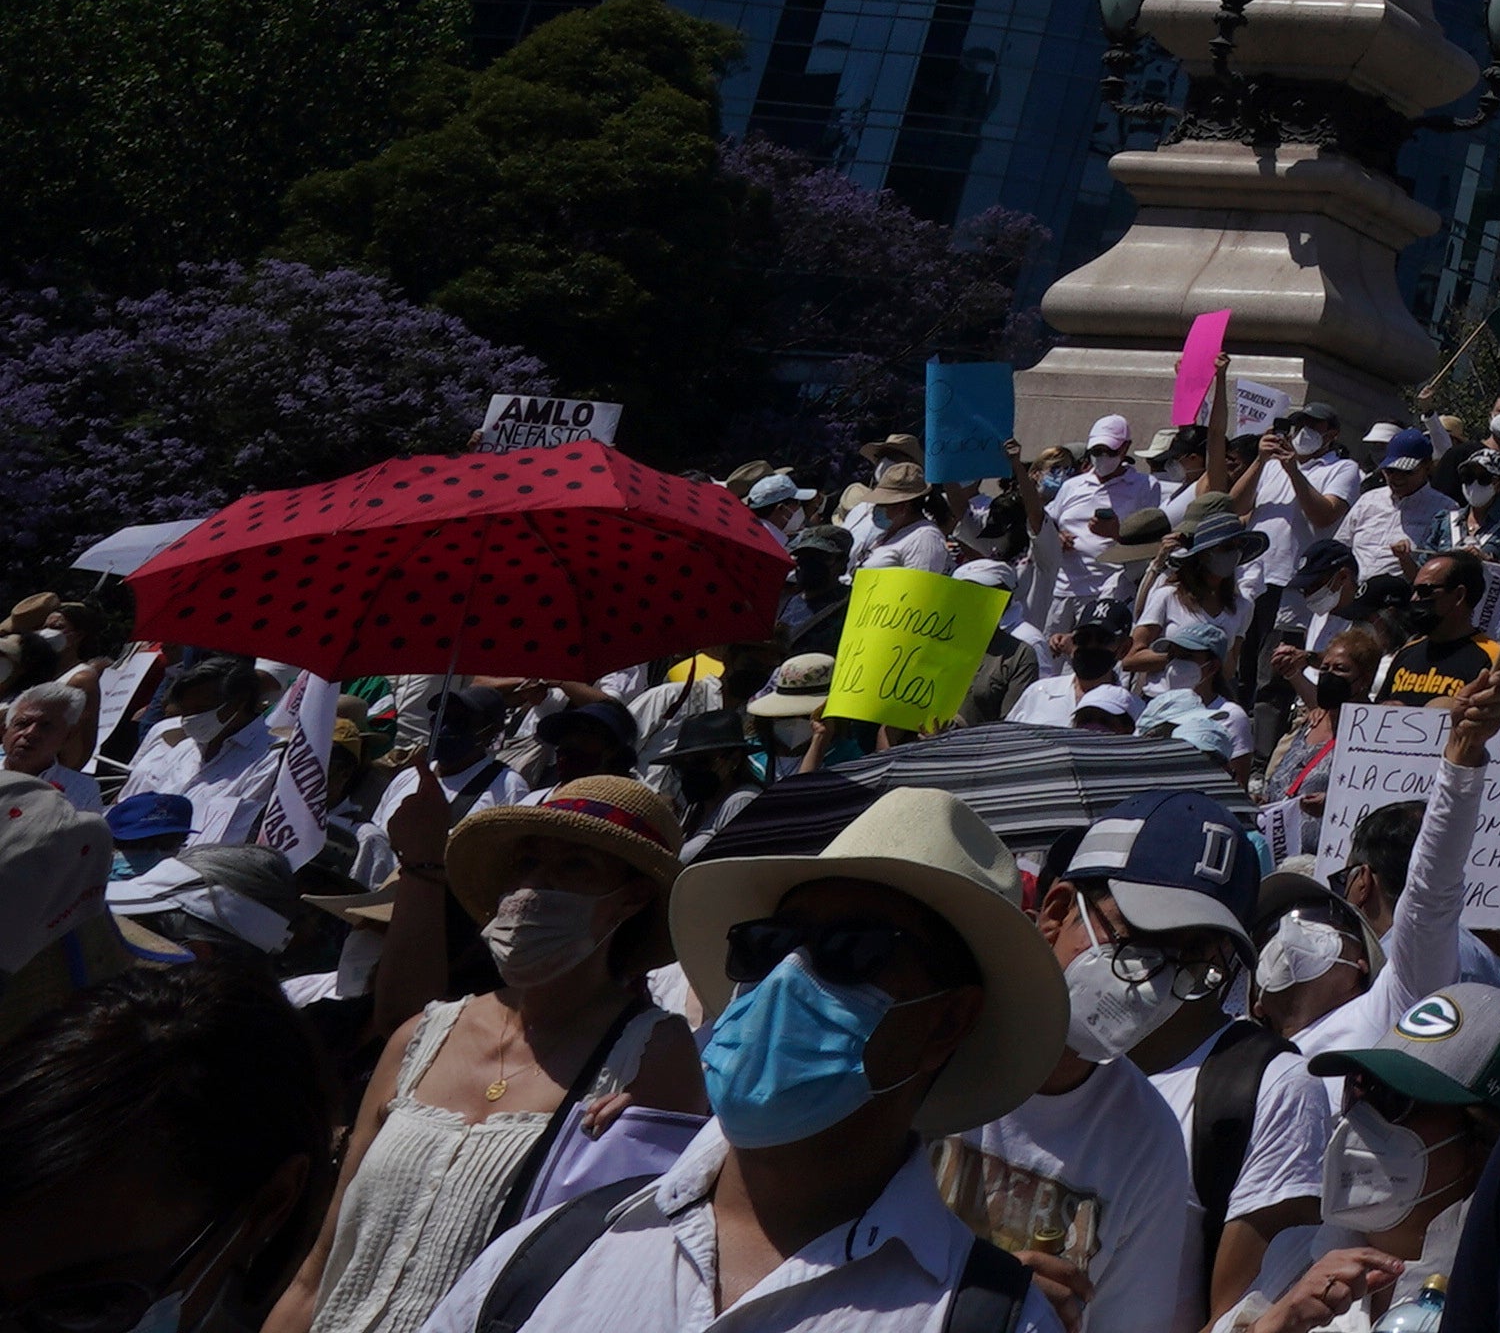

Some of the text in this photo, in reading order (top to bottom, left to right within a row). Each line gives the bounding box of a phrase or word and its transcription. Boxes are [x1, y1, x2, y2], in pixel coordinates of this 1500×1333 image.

[499, 397, 595, 427] AMLO
[497, 424, 592, 448] NEFASTO
[1391, 667, 1465, 697] Steelers
[1194, 821, 1237, 885] D
